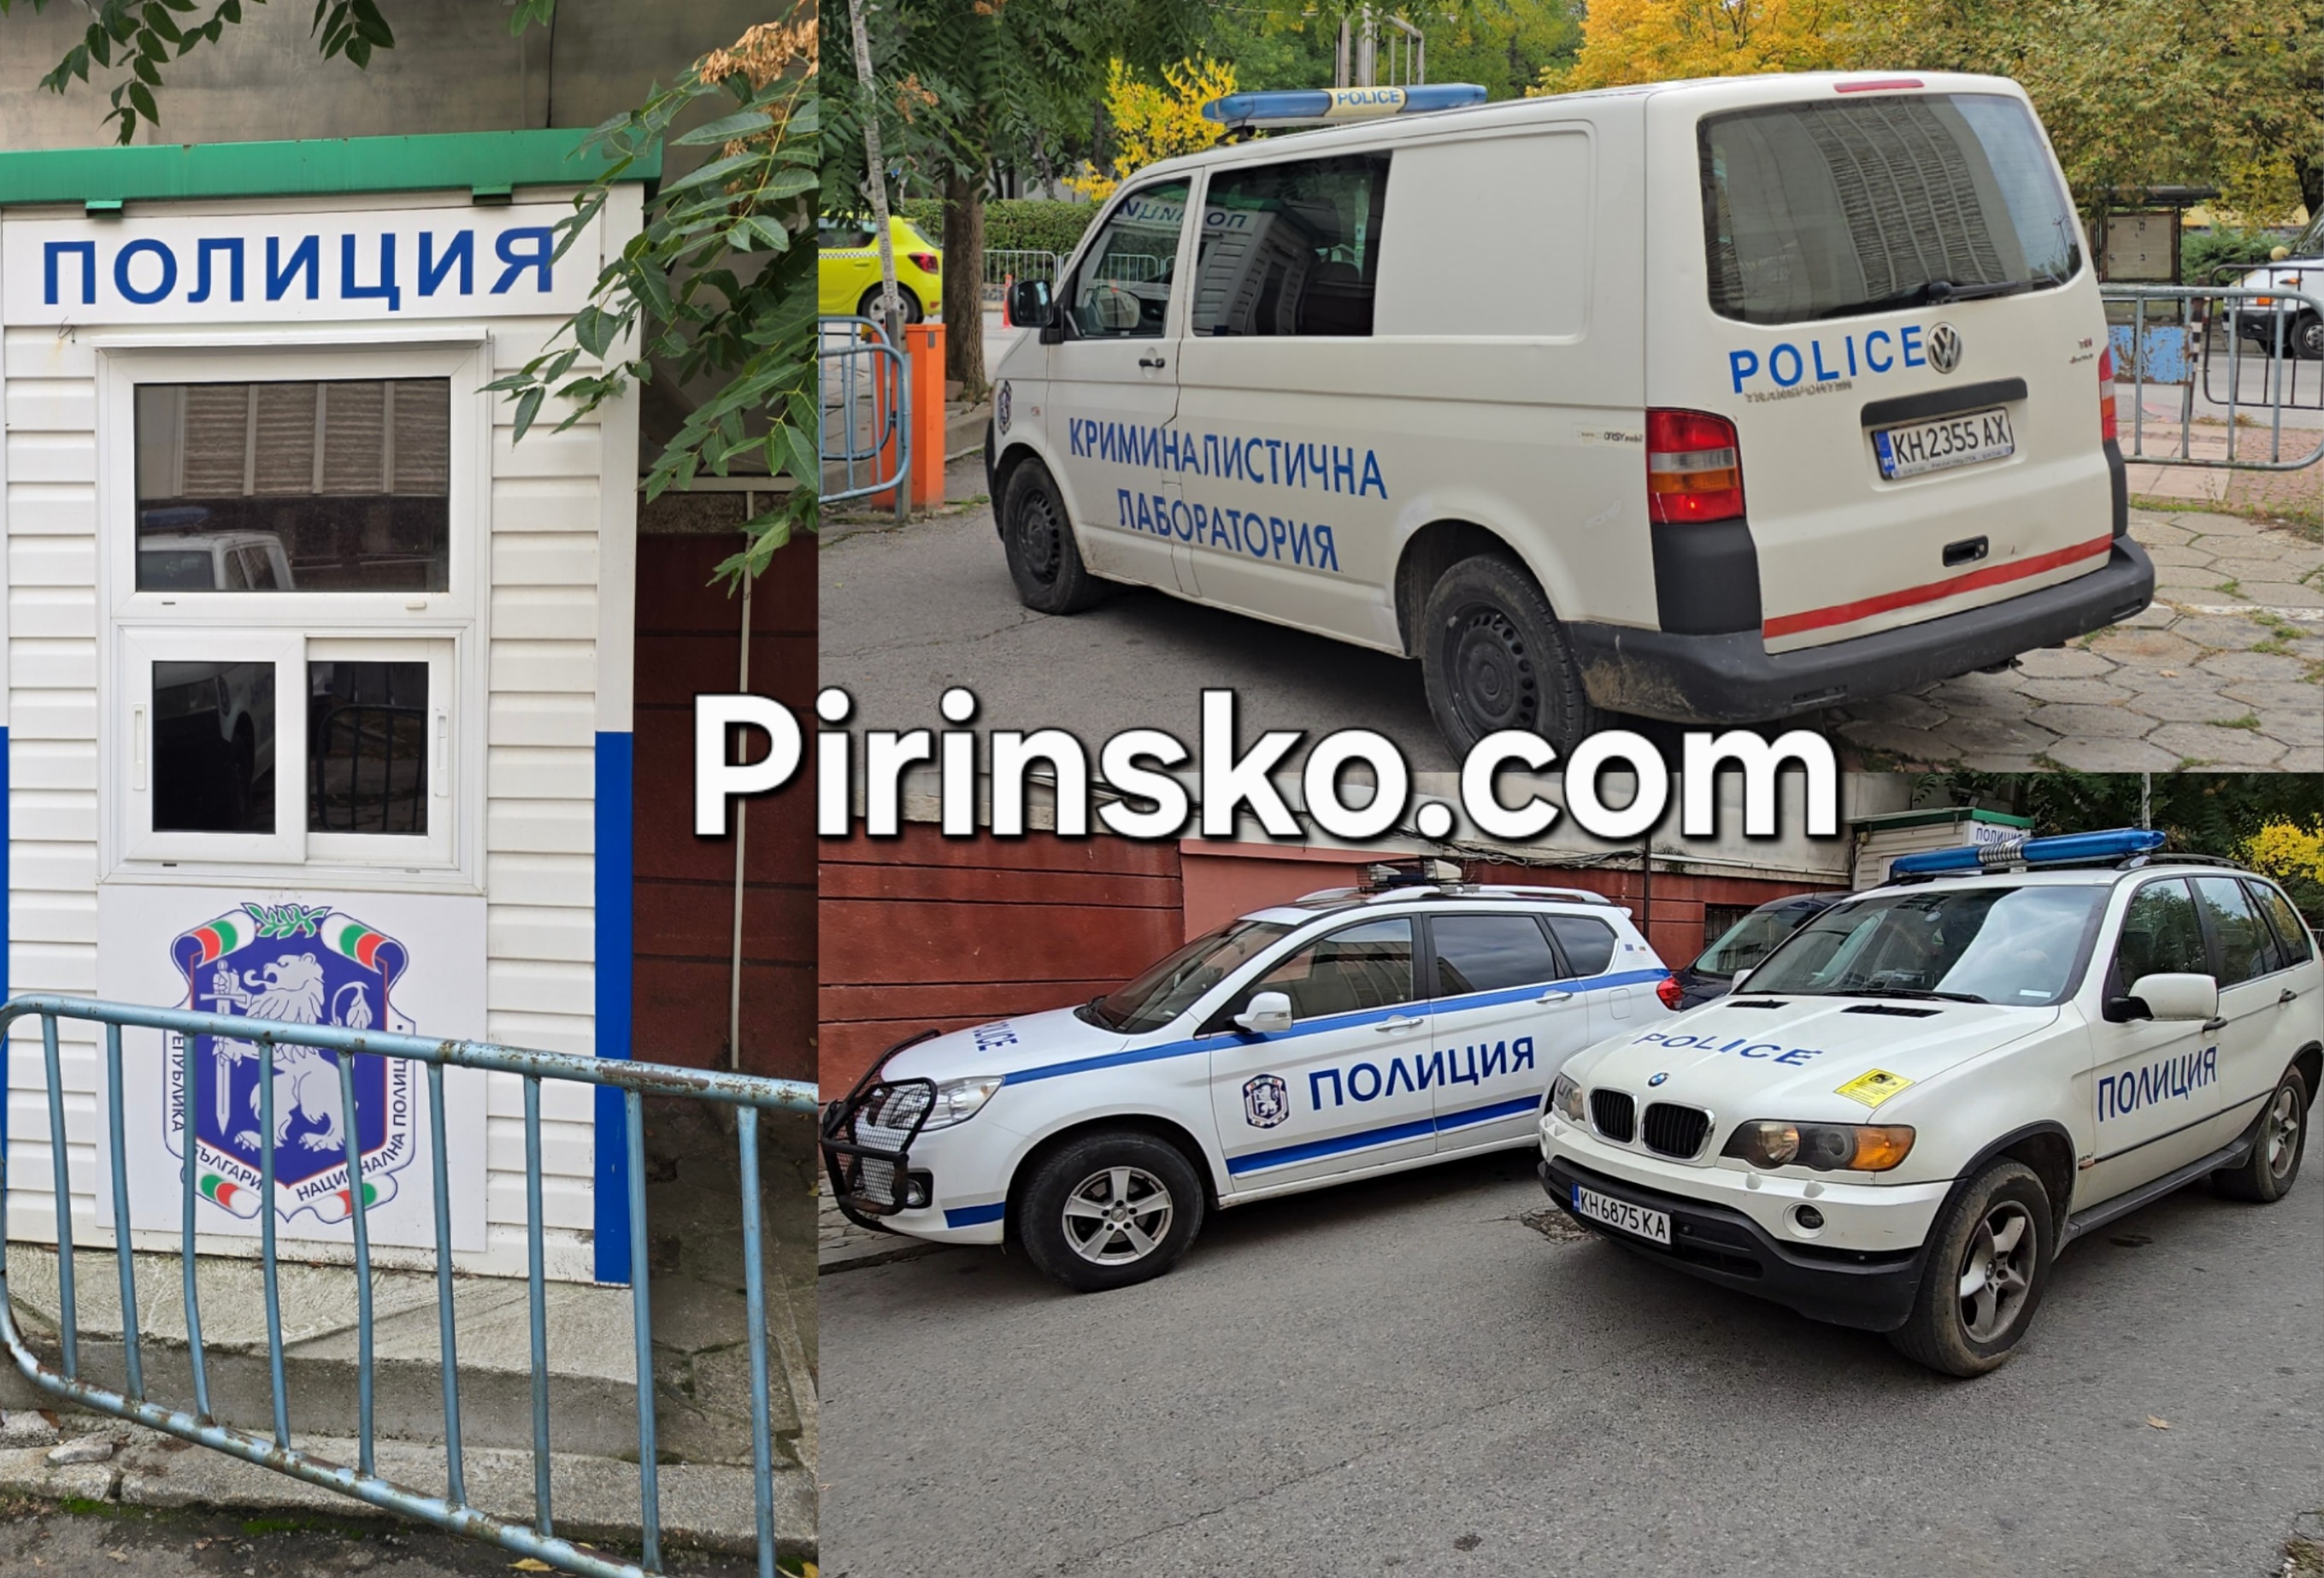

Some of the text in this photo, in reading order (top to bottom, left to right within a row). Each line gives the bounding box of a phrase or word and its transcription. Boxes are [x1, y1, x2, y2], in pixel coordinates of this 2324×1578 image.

[1337, 90, 1401, 105] POLICE
[44, 227, 554, 310] ПОЛИЦИЯ
[1729, 325, 1927, 394] POLICE
[1069, 417, 1388, 500] КРИМИНАЛИСТИЧНА
[1117, 488, 1339, 572] ЛАБОРАТОРИЯ
[1309, 1036, 1534, 1110] ПОЛИЦИЯ
[1631, 1033, 1823, 1066] POLICE
[2098, 1045, 2216, 1122] ПОЛИЦИЯ
[172, 1029, 262, 1191] ЕПУБЛИКА ЪЛГАРИ
[296, 1058, 409, 1201] НАЦИНАЛНА ПОЛИЦ
